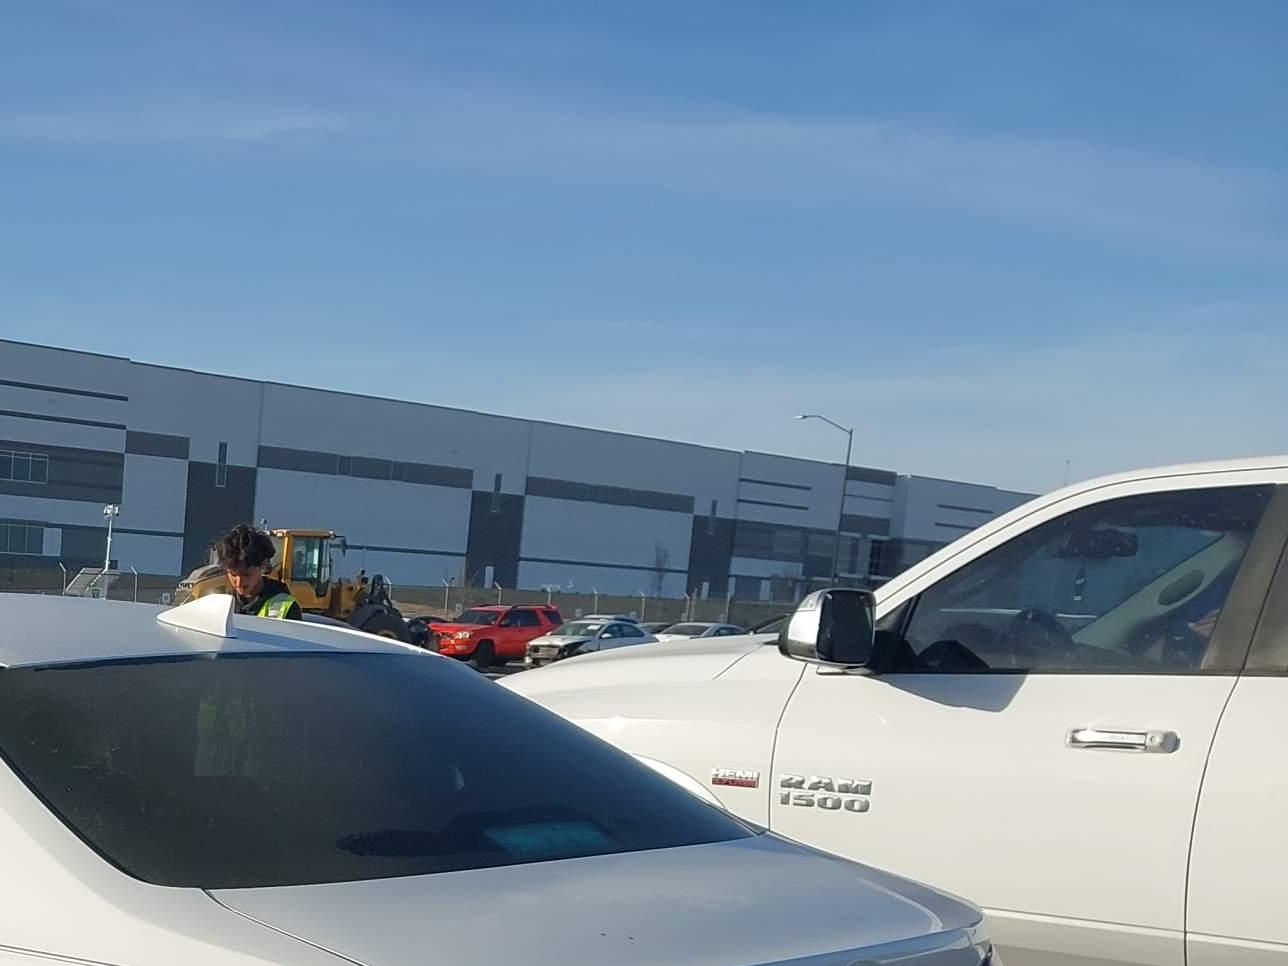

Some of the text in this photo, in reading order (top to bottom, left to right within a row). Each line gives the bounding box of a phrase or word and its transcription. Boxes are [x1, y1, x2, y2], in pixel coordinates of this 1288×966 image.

[711, 767, 760, 780] HEMI
[779, 774, 872, 796] RAM
[778, 791, 871, 813] 1500
